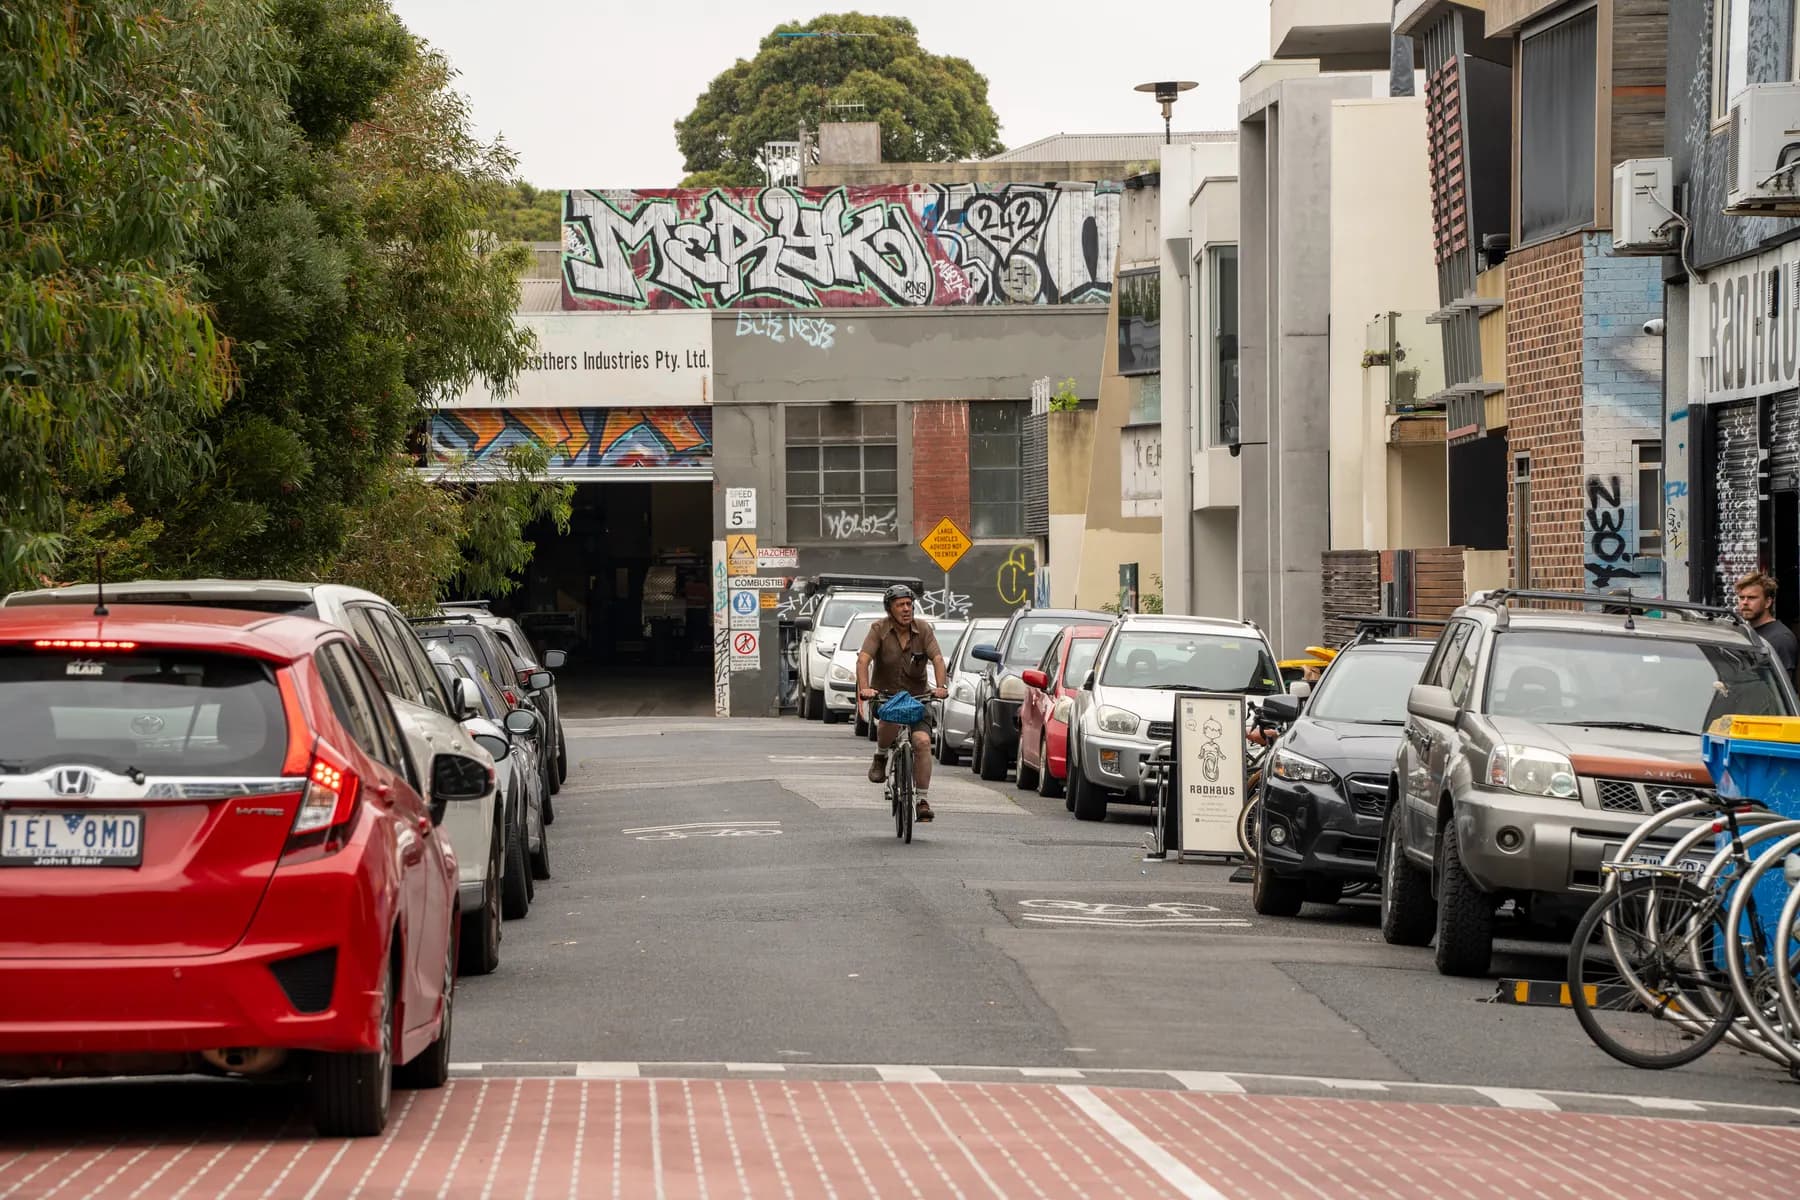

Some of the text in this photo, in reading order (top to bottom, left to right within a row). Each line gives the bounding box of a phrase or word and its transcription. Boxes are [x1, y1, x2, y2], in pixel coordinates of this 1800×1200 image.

[584, 351, 649, 370] Industries
[656, 350, 681, 372] Pty.
[686, 349, 710, 369] Ltd.
[729, 490, 752, 498] SPEED
[732, 500, 750, 508] LIMIT
[732, 511, 743, 526] 5
[757, 549, 796, 557] HAZCHEM
[734, 579, 783, 587] COMBUSTIB
[10, 819, 136, 848] 1EL 8MD
[34, 857, 104, 866] John Blair
